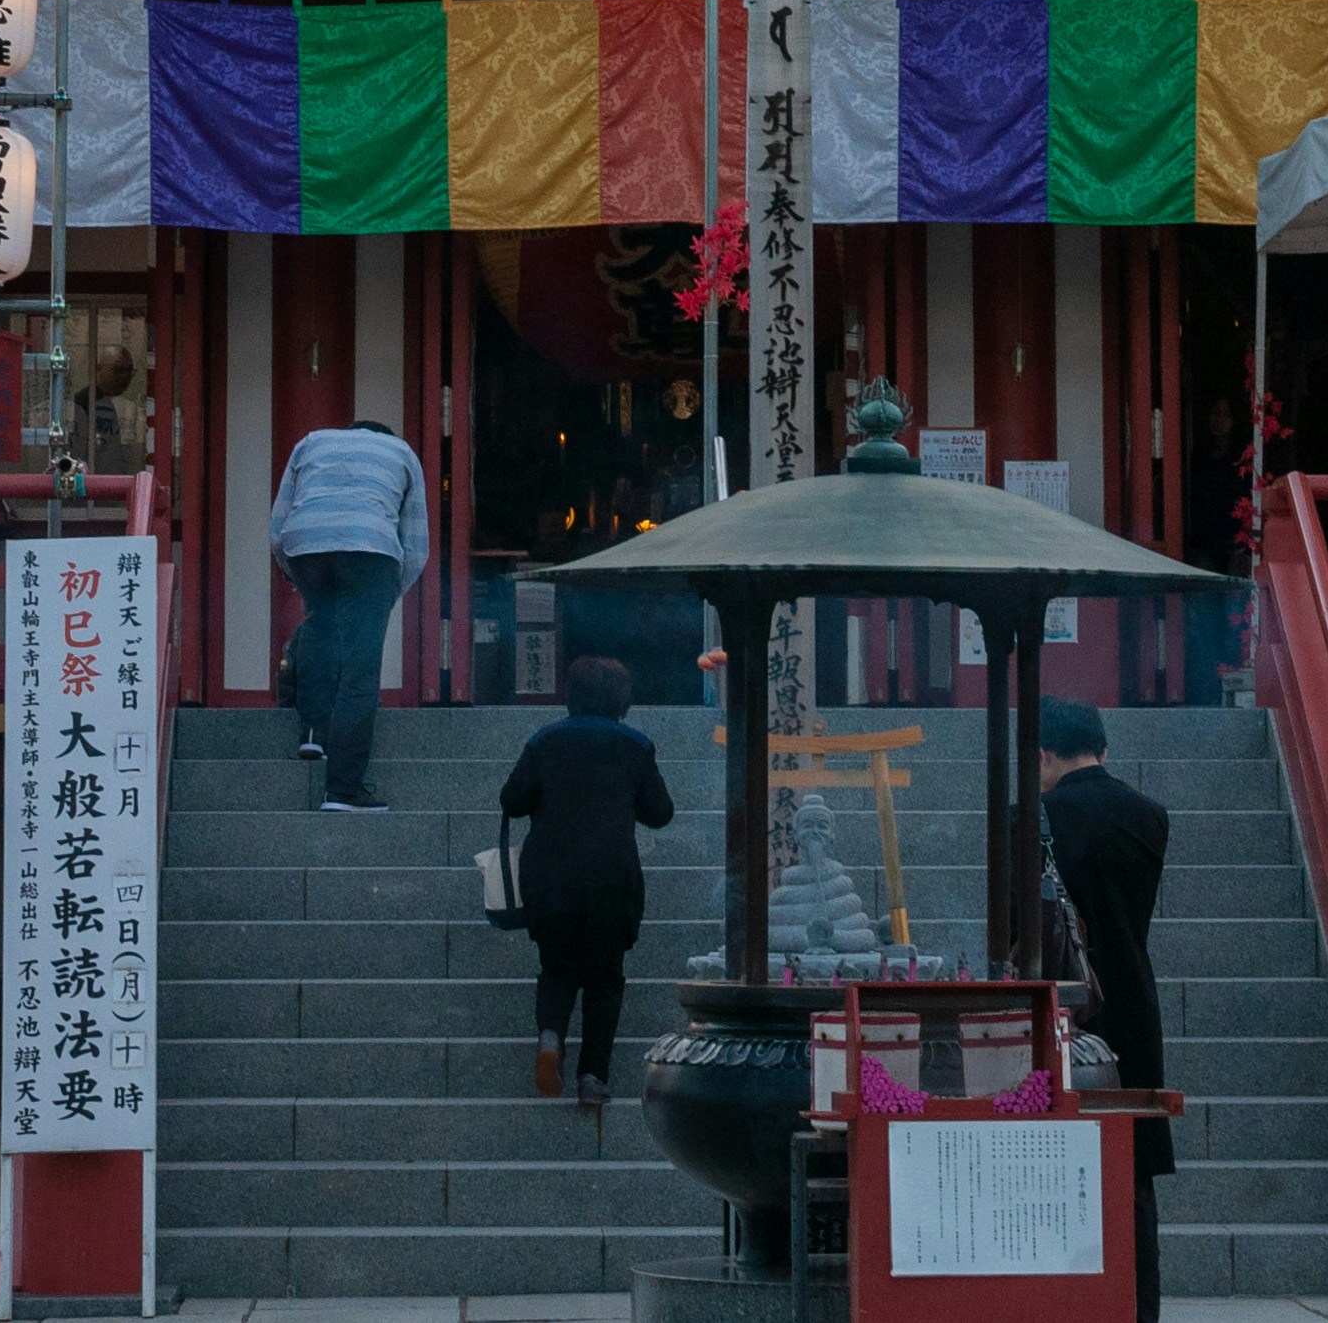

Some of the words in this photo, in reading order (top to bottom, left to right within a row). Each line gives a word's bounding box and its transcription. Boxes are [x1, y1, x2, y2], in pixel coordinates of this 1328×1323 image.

[58, 561, 103, 697] 初巳祭
[51, 711, 107, 1121] 大般若転読法要
